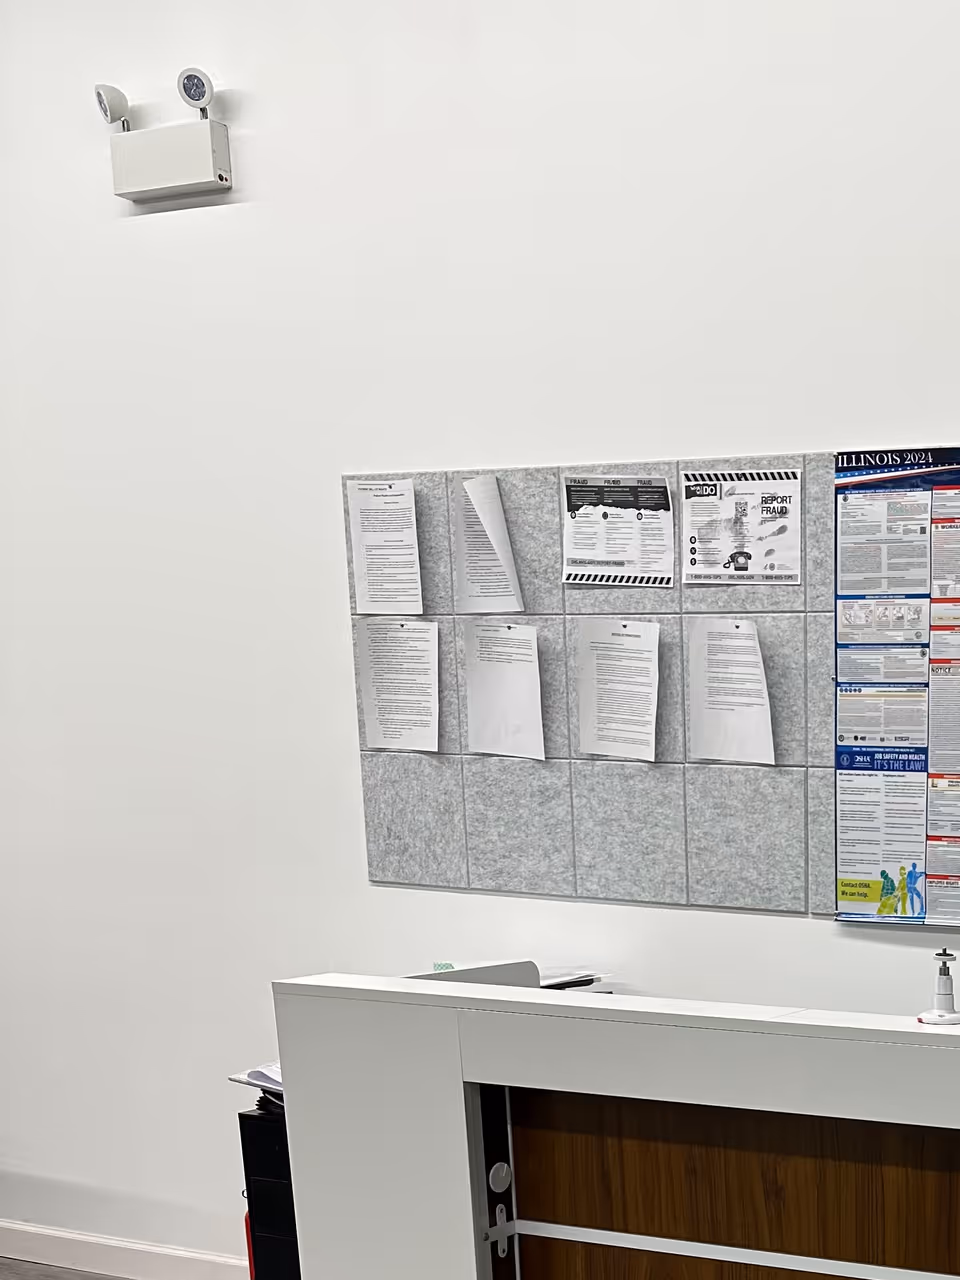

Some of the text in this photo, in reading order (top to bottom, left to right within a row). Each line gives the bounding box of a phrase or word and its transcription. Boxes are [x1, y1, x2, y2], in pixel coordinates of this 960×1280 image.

[838, 451, 934, 467] ILLINOIS 2024
[703, 486, 716, 495] DO
[761, 496, 793, 505] REPORT
[761, 506, 787, 515] FRAUD
[874, 760, 925, 771] IT'S THE LAW!
